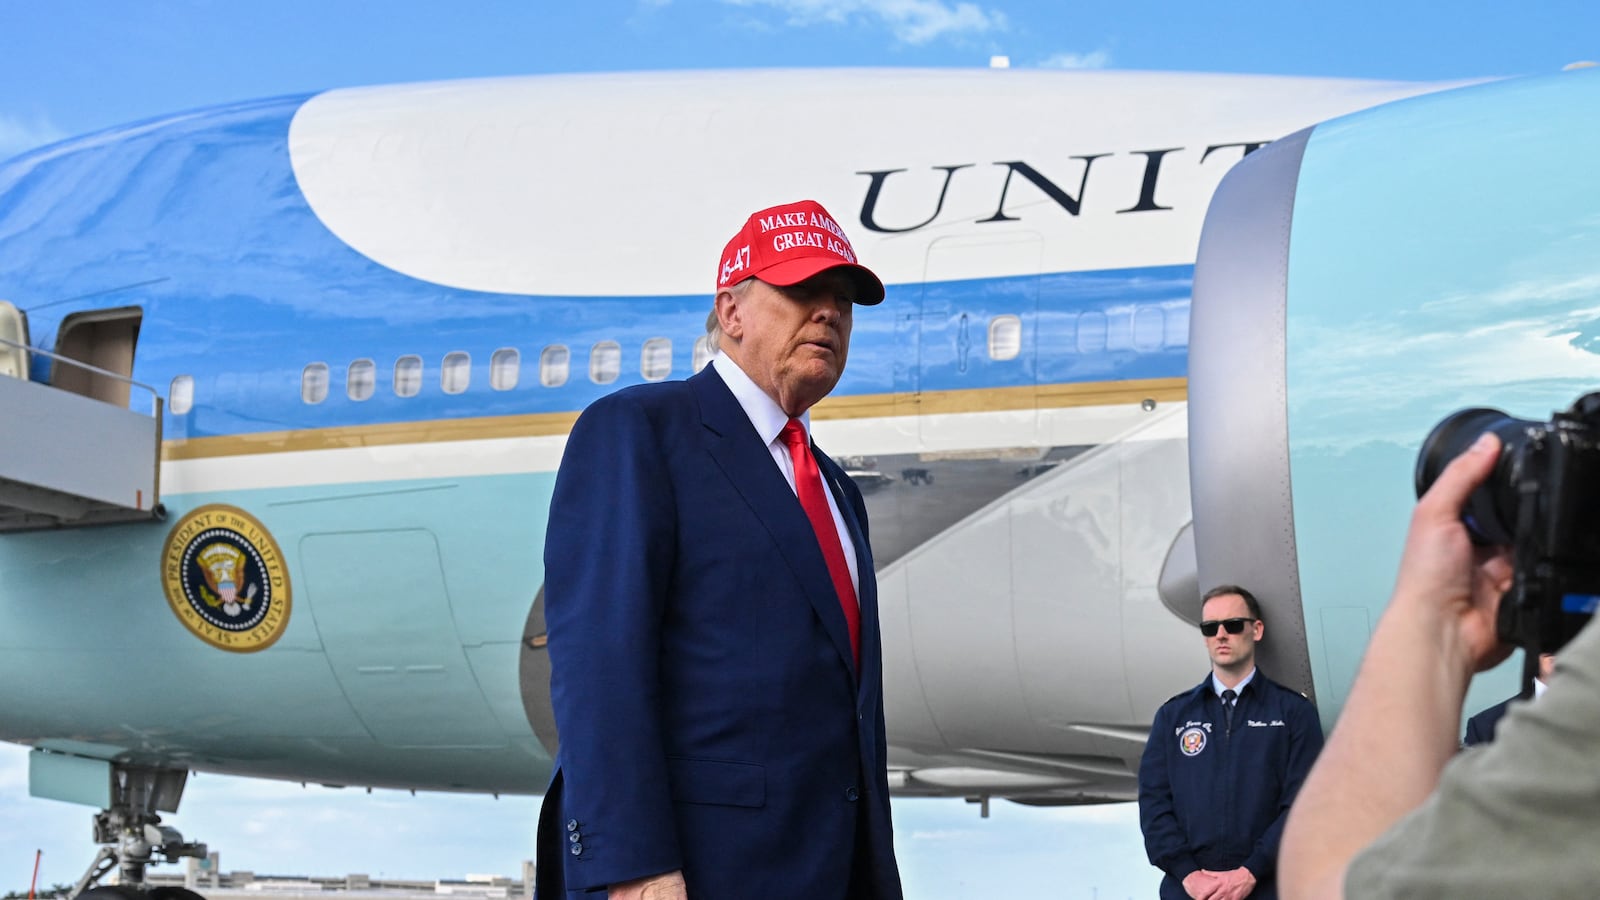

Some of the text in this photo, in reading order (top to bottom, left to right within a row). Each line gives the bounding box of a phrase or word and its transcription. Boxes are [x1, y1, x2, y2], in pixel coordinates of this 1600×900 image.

[759, 211, 850, 245] MAKE AMER
[773, 231, 824, 252] GREAT
[216, 514, 227, 523] OF
[230, 517, 246, 529] THE
[168, 515, 212, 581] PRESIDENT
[249, 528, 283, 588] UNITED
[198, 621, 232, 644] SEAL
[252, 599, 283, 640] STATES
